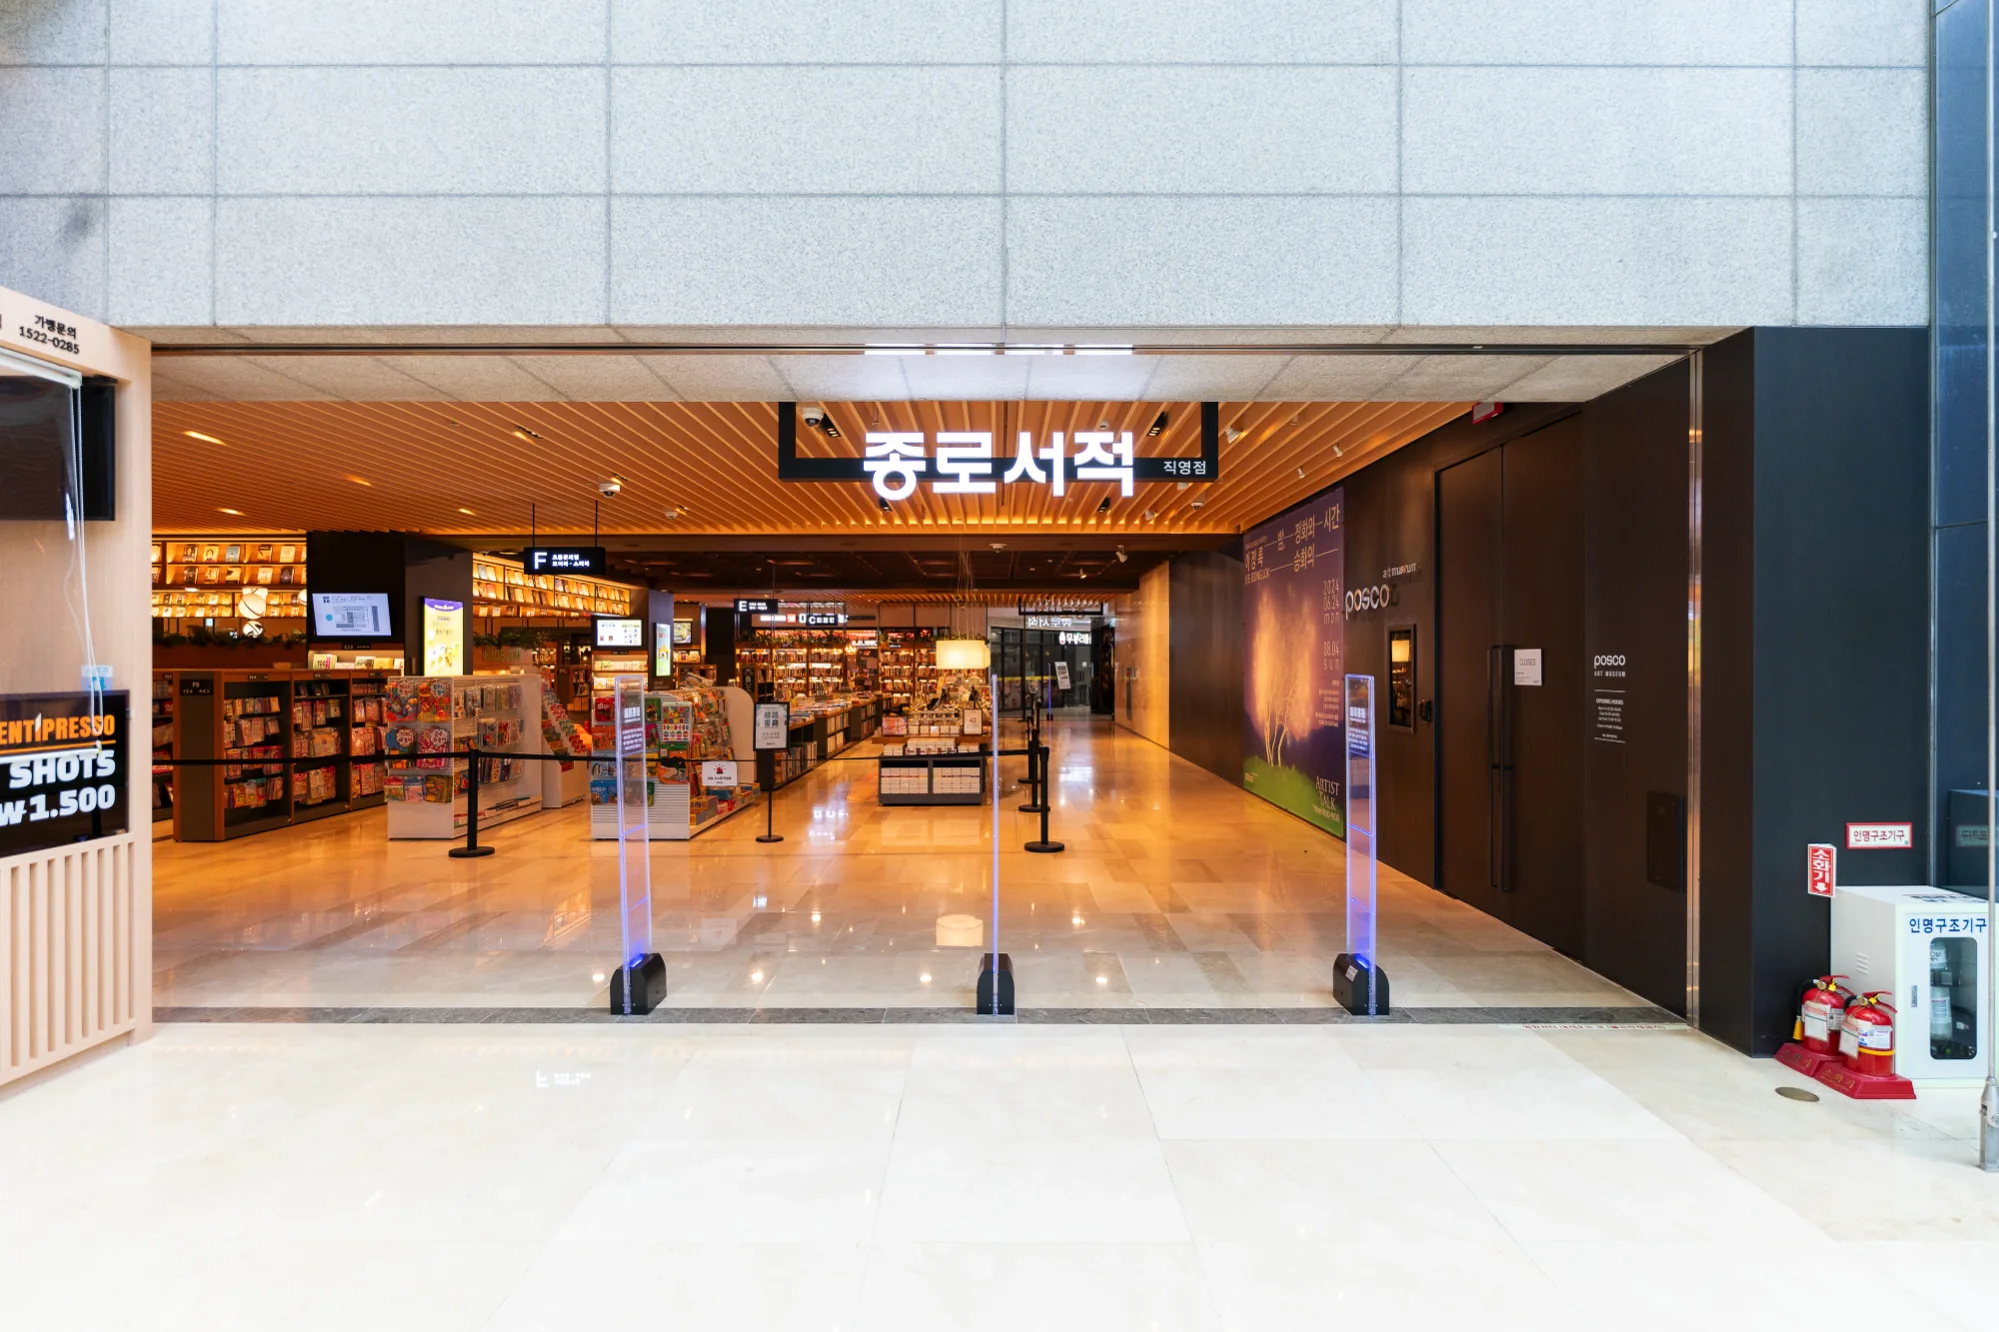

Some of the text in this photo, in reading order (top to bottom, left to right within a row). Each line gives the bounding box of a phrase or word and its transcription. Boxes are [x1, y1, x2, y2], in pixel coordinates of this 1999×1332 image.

[35, 315, 76, 339] 가맹문의
[20, 326, 79, 354] 1522-0285
[863, 431, 1134, 501] 종로서적
[1163, 460, 1206, 475] 직영점
[1323, 503, 1339, 533] 시간
[534, 551, 548, 570] F
[1293, 544, 1315, 572] 승화의
[1323, 578, 1339, 595] 2024
[739, 600, 748, 612] E
[1345, 584, 1390, 620] posco
[1594, 655, 1626, 669] posco
[9, 750, 116, 789] SHOTS
[1316, 775, 1340, 796] ARTIST
[1319, 790, 1336, 811] TALK
[1853, 829, 1906, 842] 인명구조기구
[1812, 850, 1831, 883] 소화기
[1909, 917, 1988, 934] 인명구조기구
